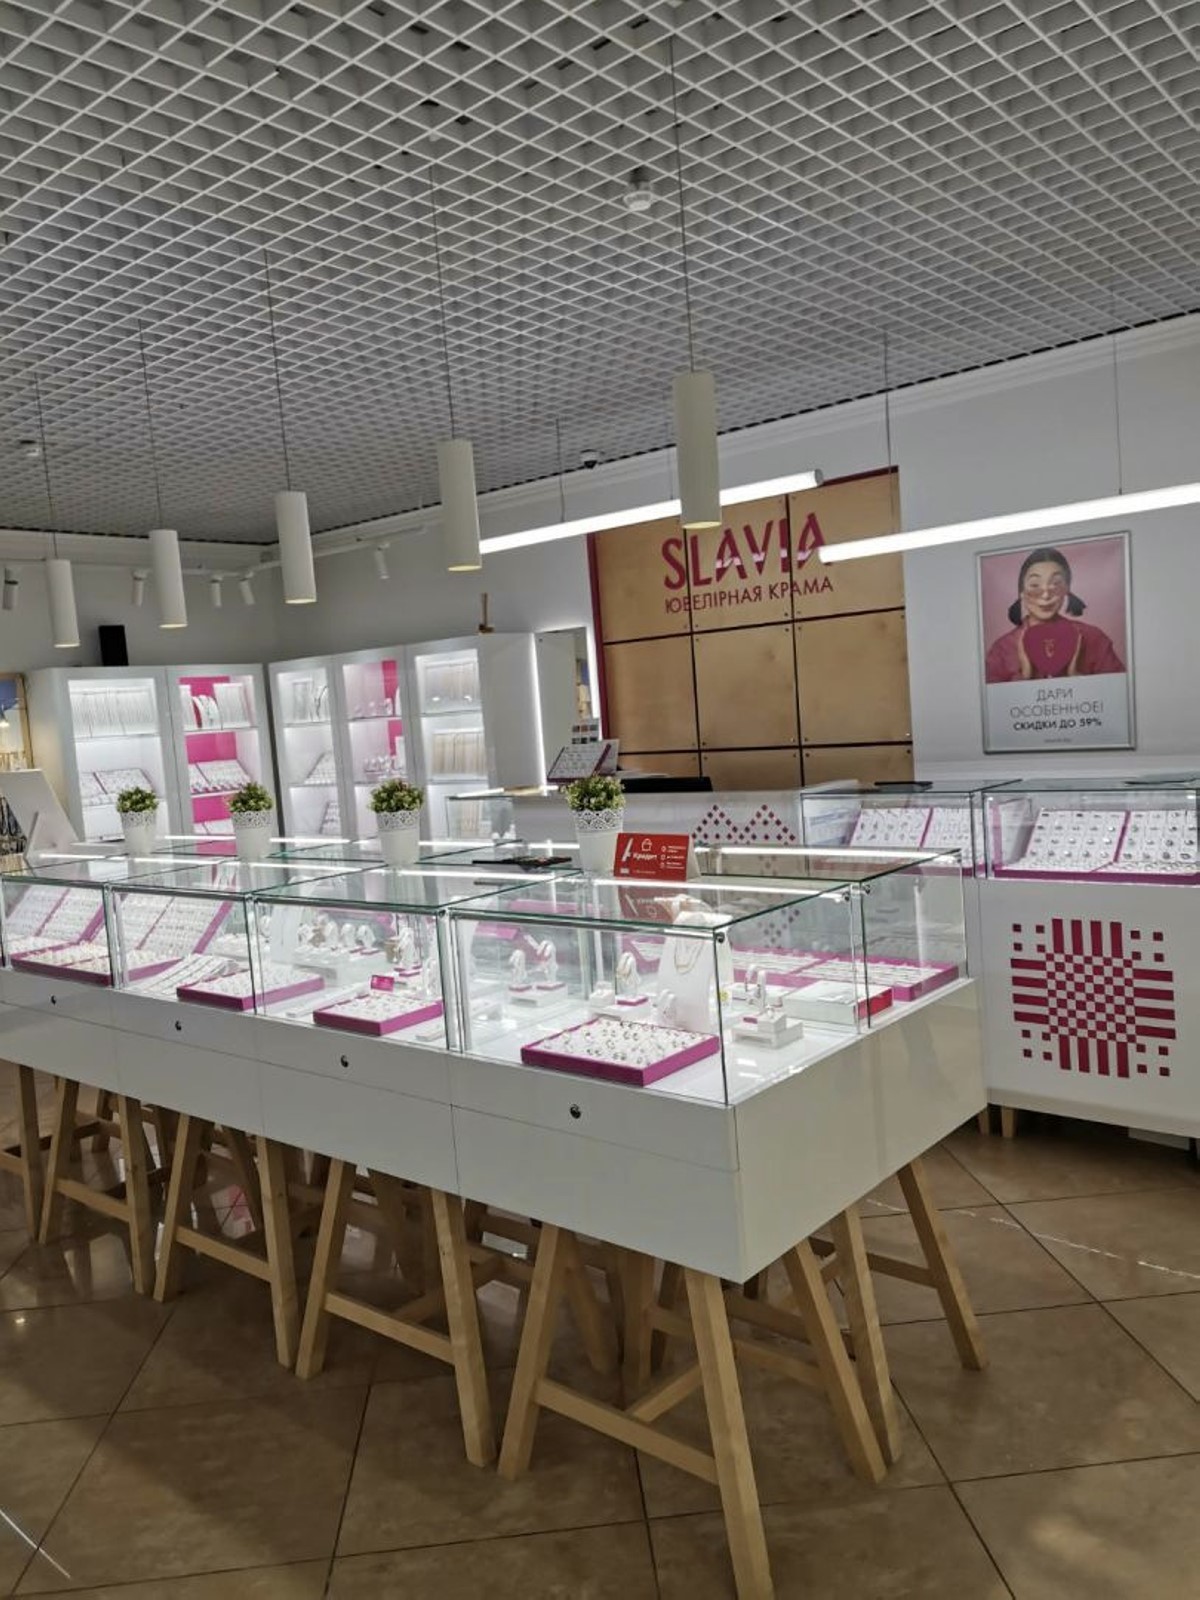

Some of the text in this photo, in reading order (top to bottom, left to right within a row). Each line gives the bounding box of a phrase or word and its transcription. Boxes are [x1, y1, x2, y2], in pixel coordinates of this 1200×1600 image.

[661, 512, 832, 590] SLAVIA
[664, 575, 834, 614] ЮВЕЛІРНАЯ КРАМА
[1036, 688, 1074, 702] ДАРИ
[1010, 701, 1104, 718] ОСОБЕННОЕ!
[1013, 720, 1057, 731] СКИДКИ
[1059, 719, 1076, 729] ДО
